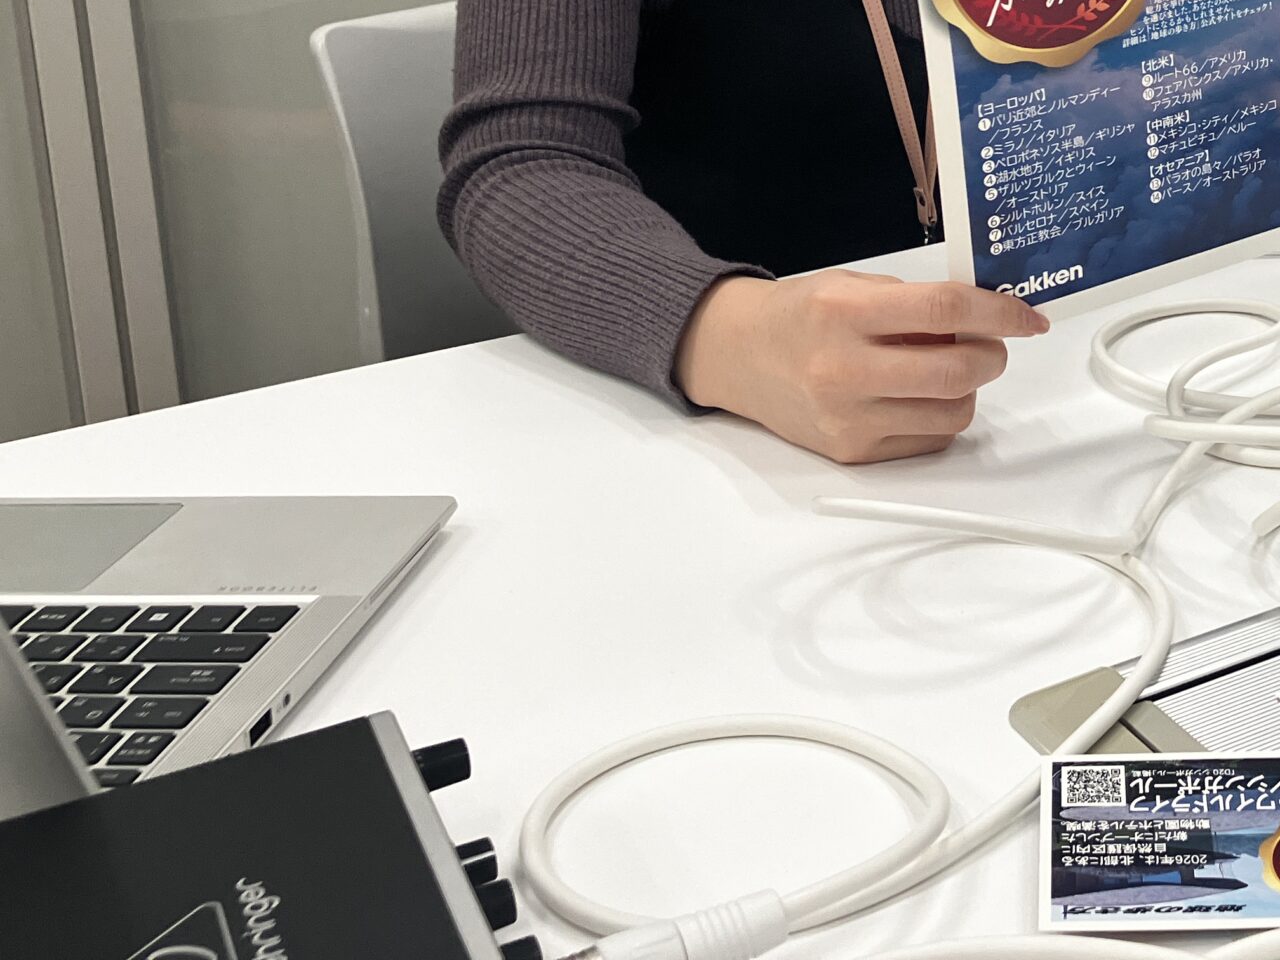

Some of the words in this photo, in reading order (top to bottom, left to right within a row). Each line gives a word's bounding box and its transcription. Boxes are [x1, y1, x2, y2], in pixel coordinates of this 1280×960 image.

[1151, 88, 1202, 112] アラスカ州
[1058, 818, 1210, 831] 動物園とホテルを満喫。
[1060, 831, 1187, 842] 新たにオープンした
[1060, 843, 1167, 854] 自然保護区内に
[1060, 852, 1208, 866] 2026年は、北部にある
[1066, 903, 1247, 915] 地球の歩き方
